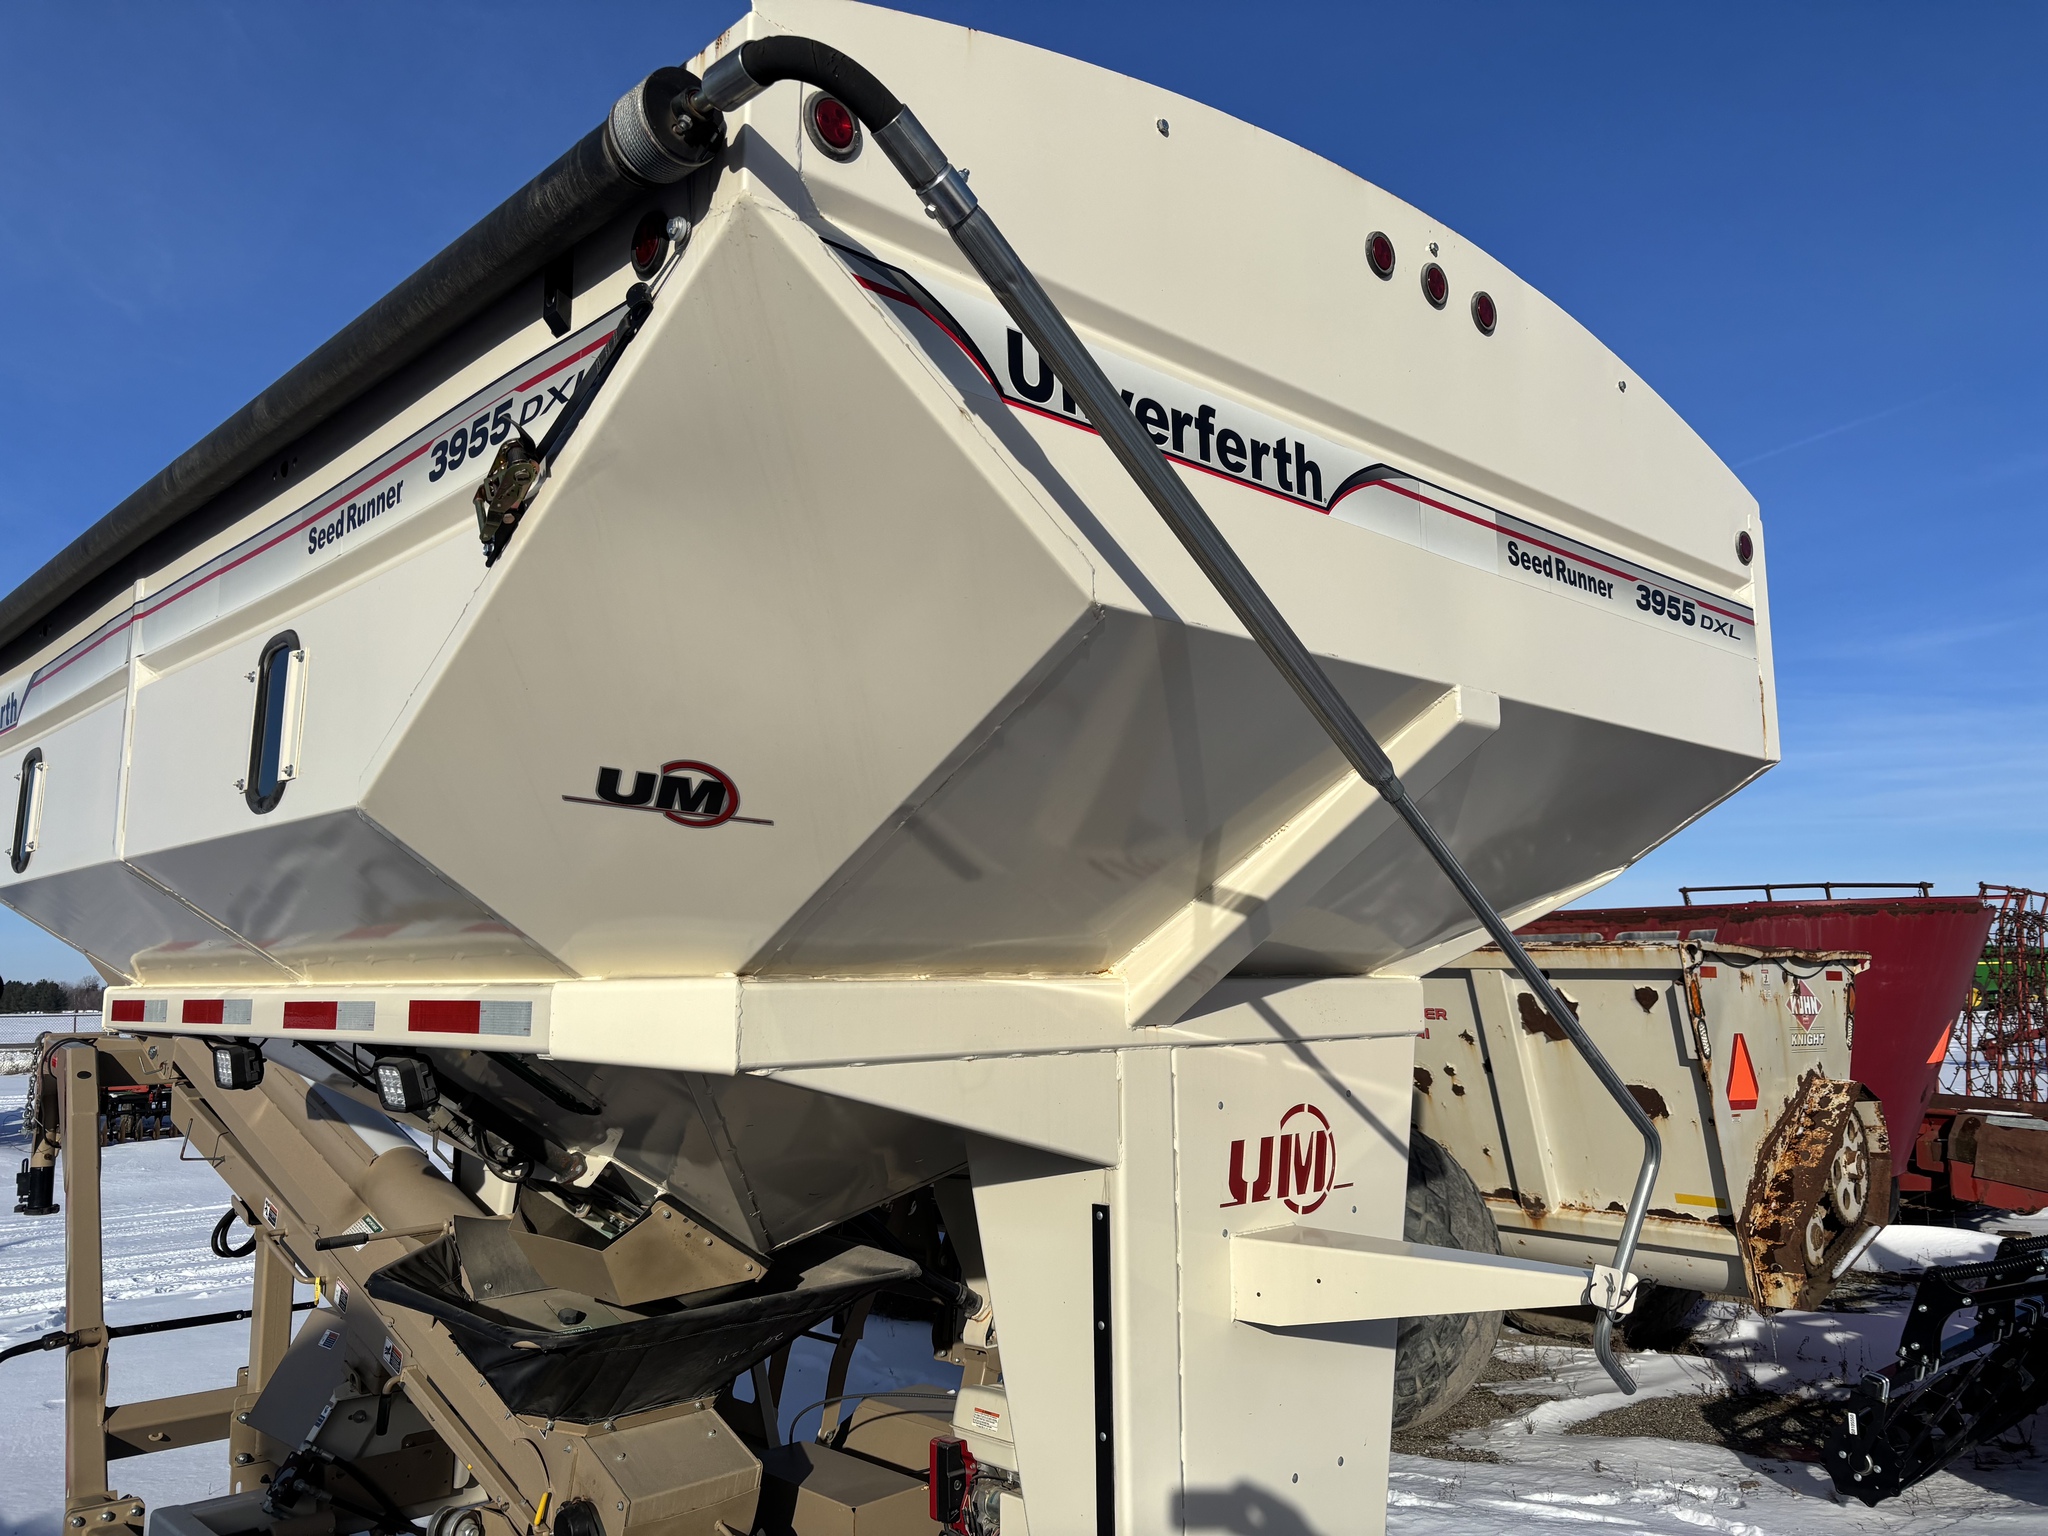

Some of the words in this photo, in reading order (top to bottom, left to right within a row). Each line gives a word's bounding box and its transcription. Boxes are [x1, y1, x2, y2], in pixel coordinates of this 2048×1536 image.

[1006, 326, 1324, 504] Uerferth
[307, 510, 345, 555] Seed
[346, 480, 404, 534] Runner
[429, 398, 514, 483] 3955
[1507, 541, 1554, 579] Seed
[1554, 557, 1614, 600] Runner
[1635, 584, 1696, 627] 3955
[1700, 614, 1741, 641] DXL
[595, 766, 728, 818] UM
[1790, 1032, 1826, 1047] KNIGHT
